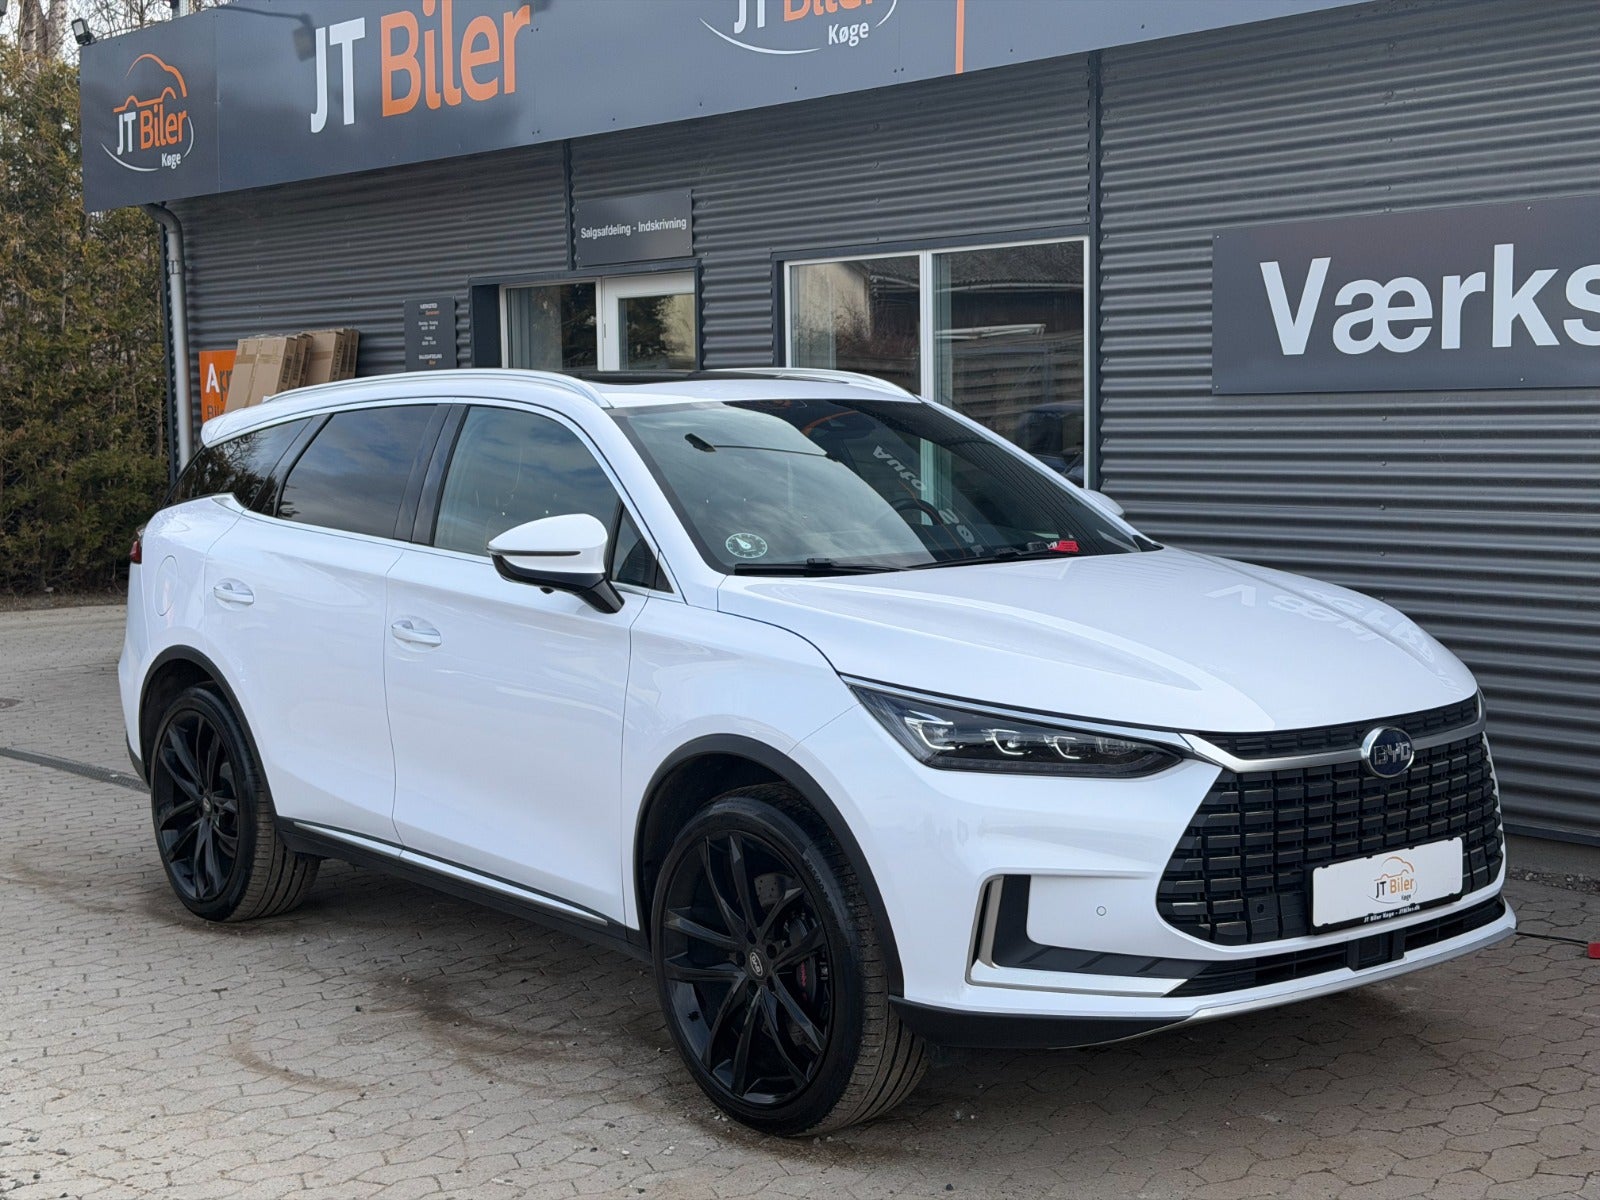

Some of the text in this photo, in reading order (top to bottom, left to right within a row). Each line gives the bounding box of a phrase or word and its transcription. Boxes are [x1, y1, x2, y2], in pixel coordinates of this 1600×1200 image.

[828, 22, 869, 47] Køge
[310, 0, 531, 134] JT Biler
[117, 104, 187, 155] JT Biler
[161, 152, 181, 169] Køge
[580, 223, 631, 239] Salgsafdeling
[638, 217, 687, 232] Indskrivning
[1259, 243, 1600, 356] Værks
[1373, 742, 1410, 766] BYD
[1375, 878, 1414, 898] JT Biler
